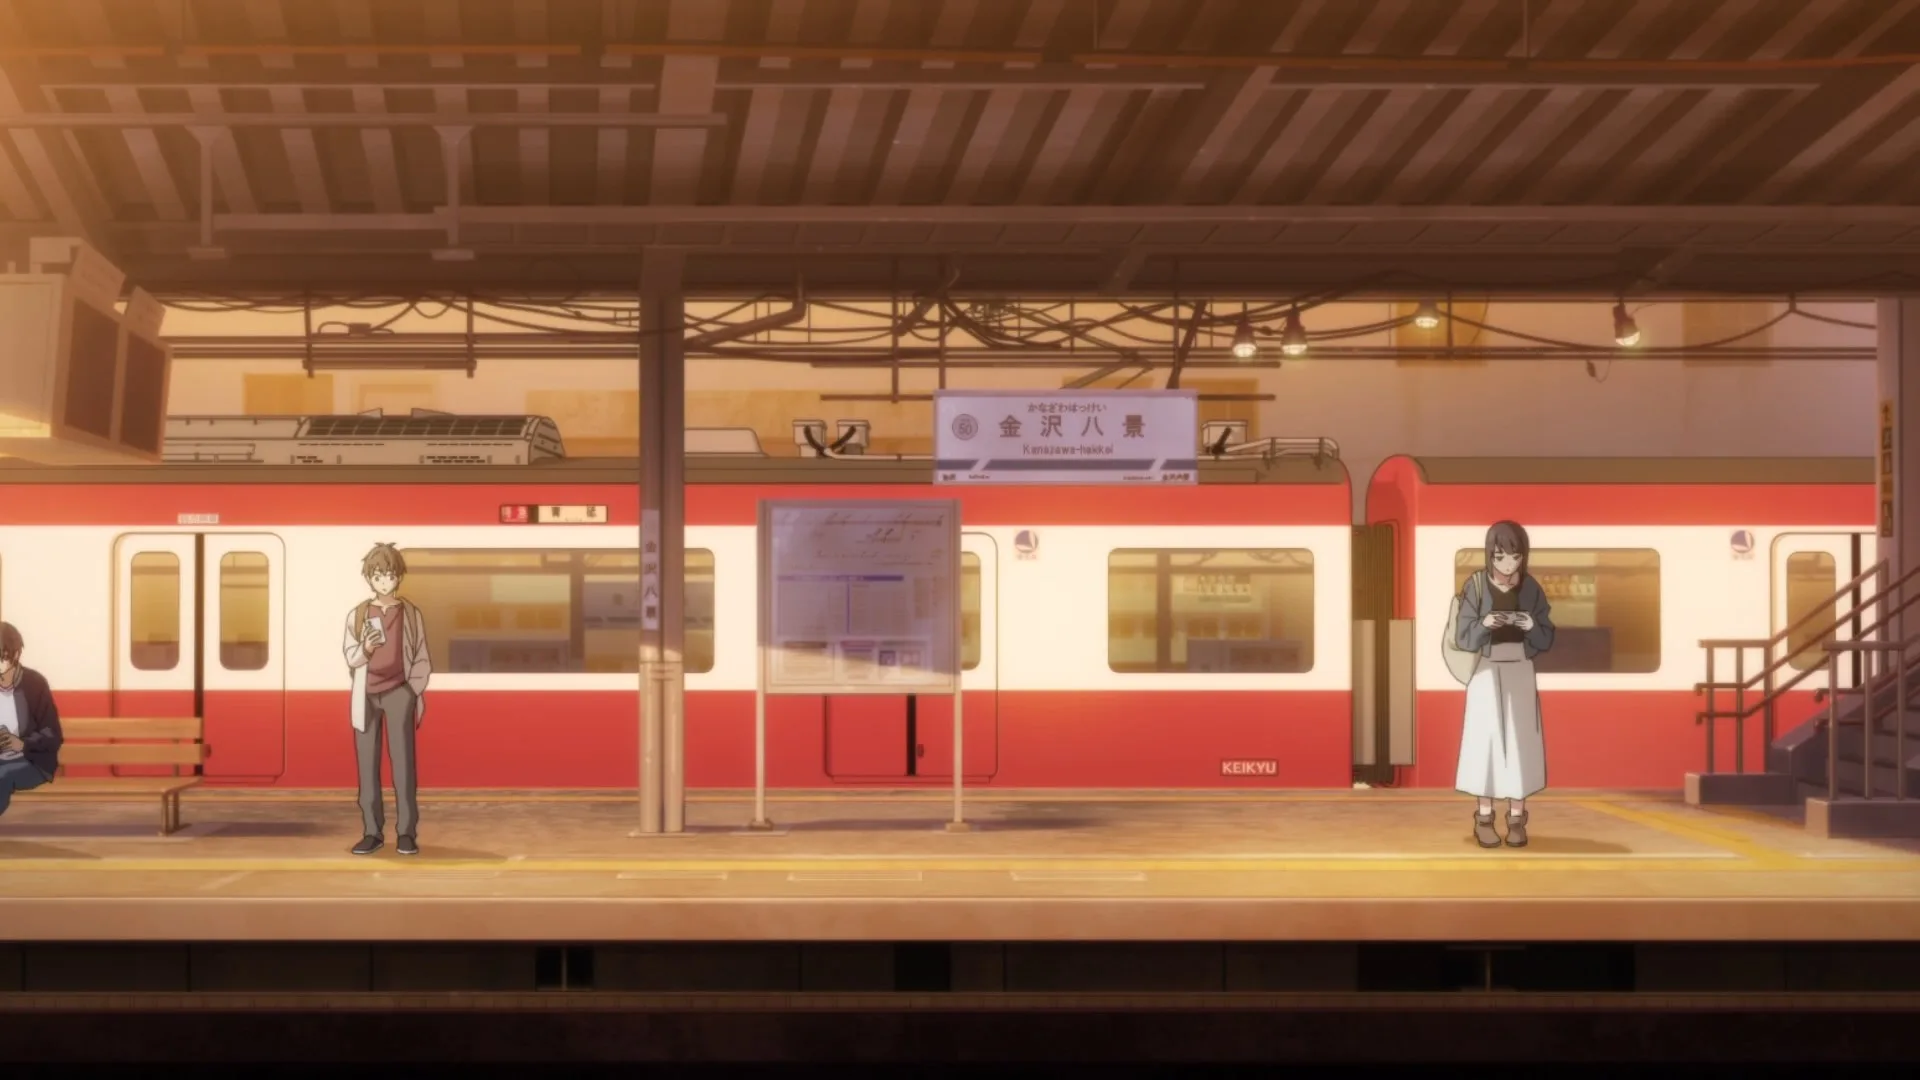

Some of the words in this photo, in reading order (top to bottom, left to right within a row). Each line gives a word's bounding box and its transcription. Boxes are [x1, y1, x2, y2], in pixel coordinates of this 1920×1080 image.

[1027, 402, 1107, 413] かなざわはっけい
[958, 422, 972, 435] 50
[998, 414, 1146, 438] 金沢八景
[1222, 761, 1277, 773] KEIKYU
